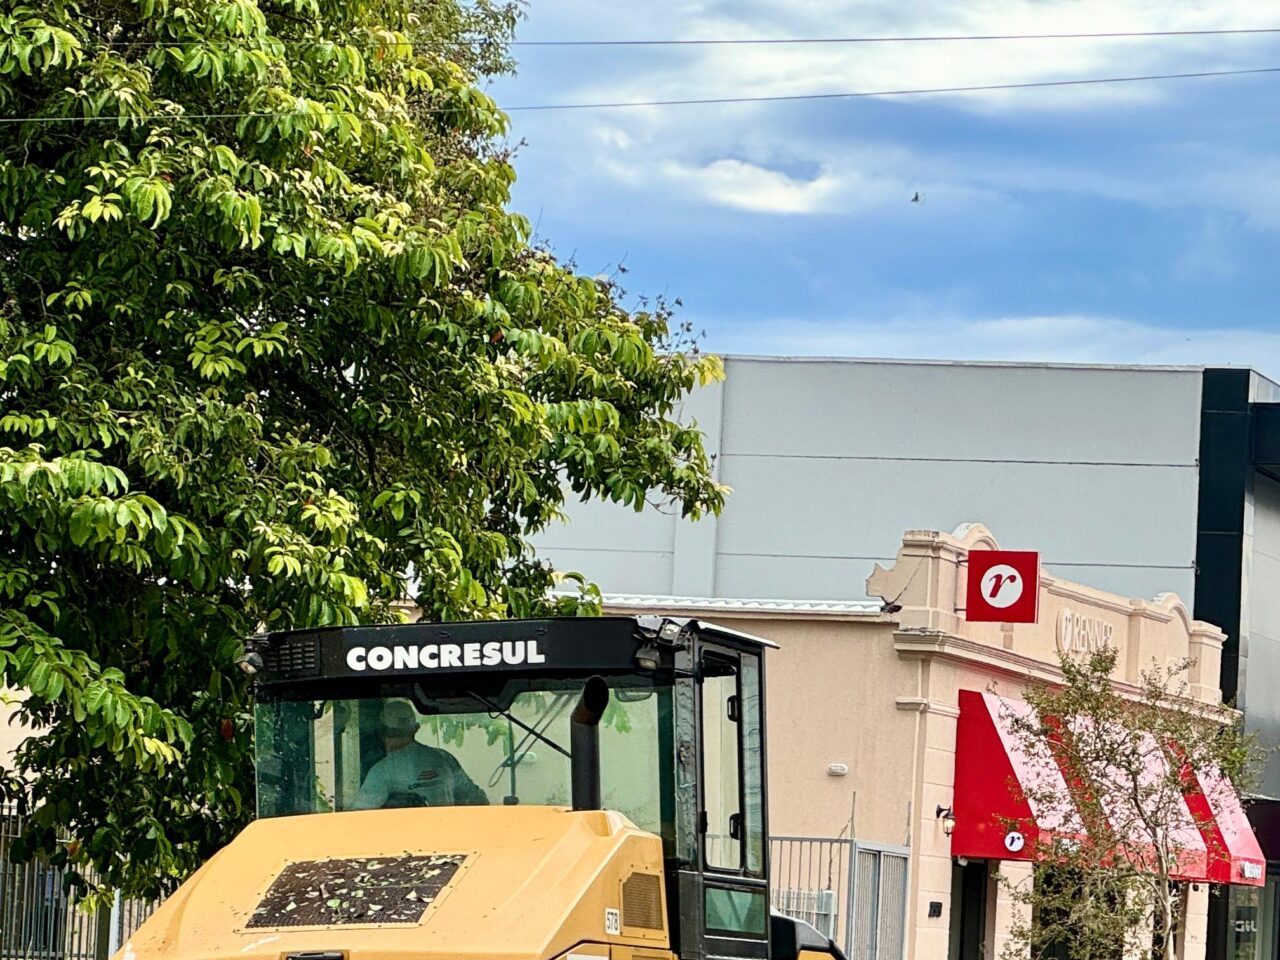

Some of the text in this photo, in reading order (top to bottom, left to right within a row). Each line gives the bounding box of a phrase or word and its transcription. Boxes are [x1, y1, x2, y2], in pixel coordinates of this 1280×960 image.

[988, 573, 1017, 598] r
[346, 640, 546, 671] CONCRESUL
[606, 911, 619, 931] 578
